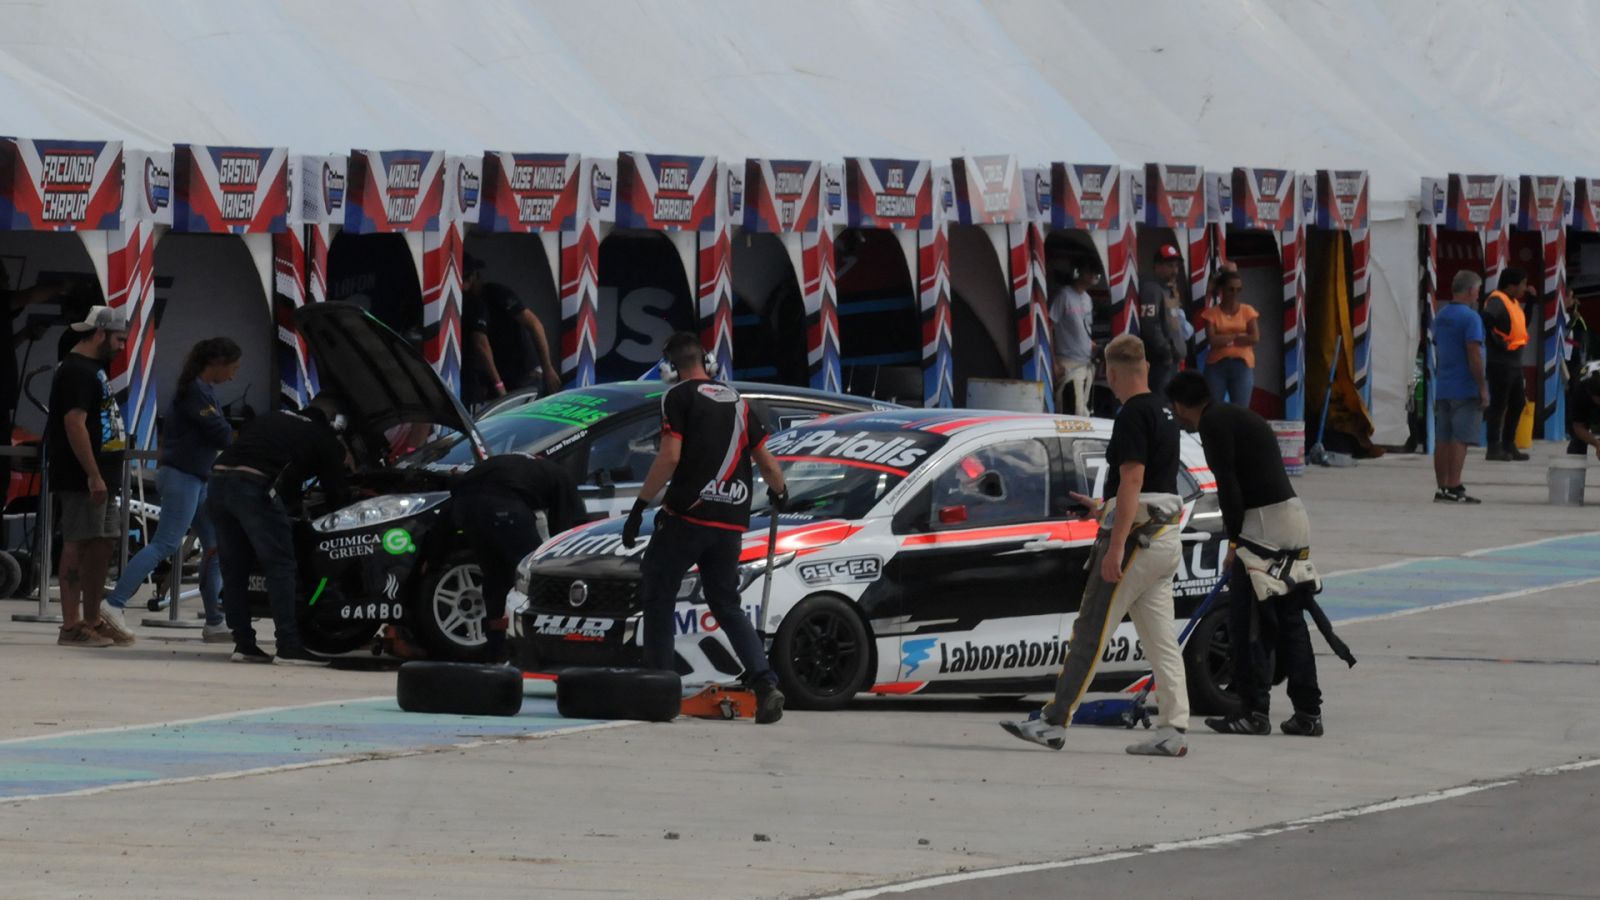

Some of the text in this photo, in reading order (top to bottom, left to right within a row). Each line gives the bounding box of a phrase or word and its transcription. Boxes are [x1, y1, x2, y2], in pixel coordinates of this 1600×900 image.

[43, 155, 95, 183] FACUNDO
[220, 159, 258, 183] GASTON
[388, 164, 420, 188] MANUEL
[511, 166, 565, 190] JOSE MANUEL
[658, 168, 688, 189] LEONEL
[42, 193, 88, 219] CHAPUR
[222, 193, 254, 218] IANSA
[519, 198, 554, 221] URCERA
[653, 199, 693, 220] LARRAURI
[702, 479, 742, 499] ALM
[320, 534, 381, 551] QUIMICA
[329, 545, 374, 560] GREEN
[341, 603, 403, 619] GARBO
